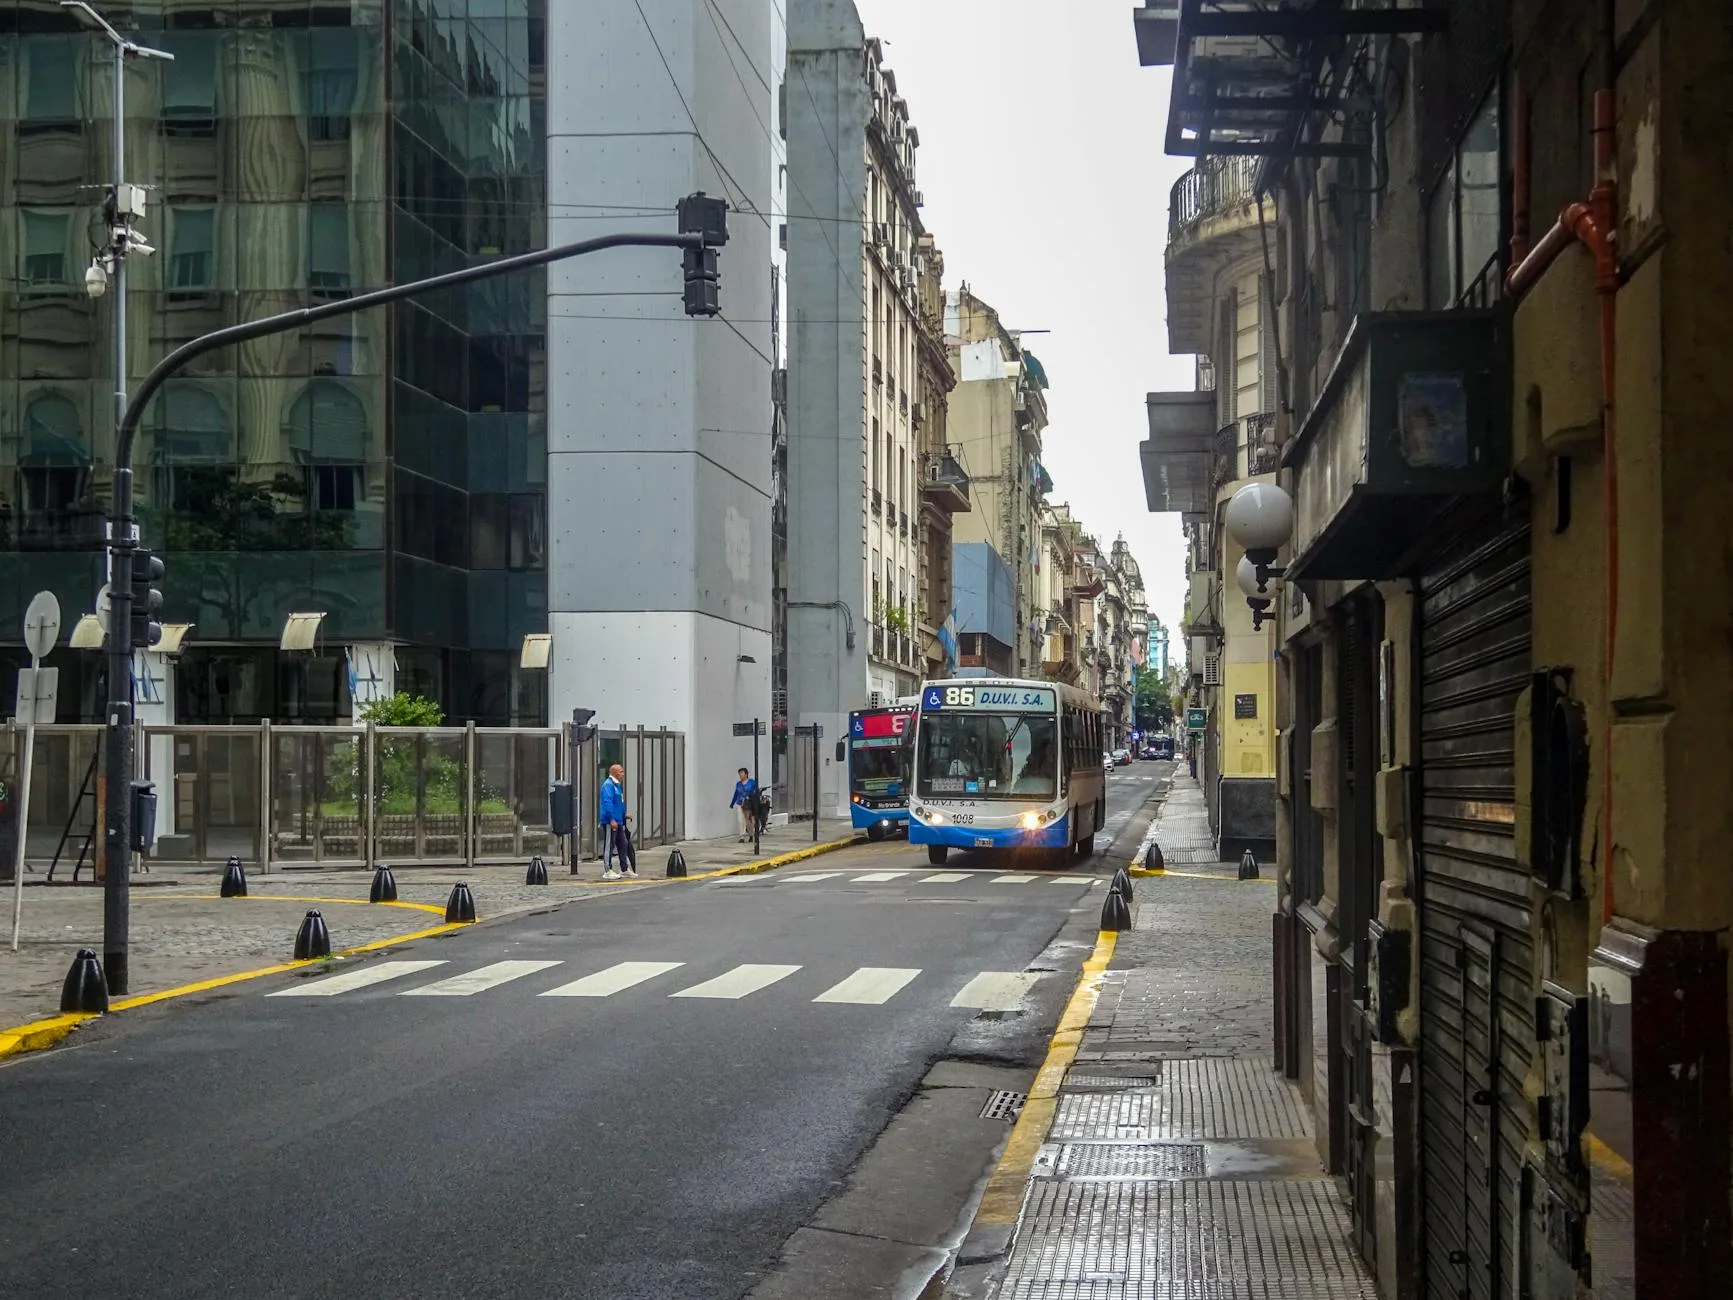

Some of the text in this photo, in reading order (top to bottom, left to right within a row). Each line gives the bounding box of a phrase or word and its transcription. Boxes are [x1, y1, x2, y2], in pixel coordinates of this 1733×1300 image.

[946, 688, 1044, 705] 86 D.U.V.I. S.A.
[952, 814, 974, 824] 1008
